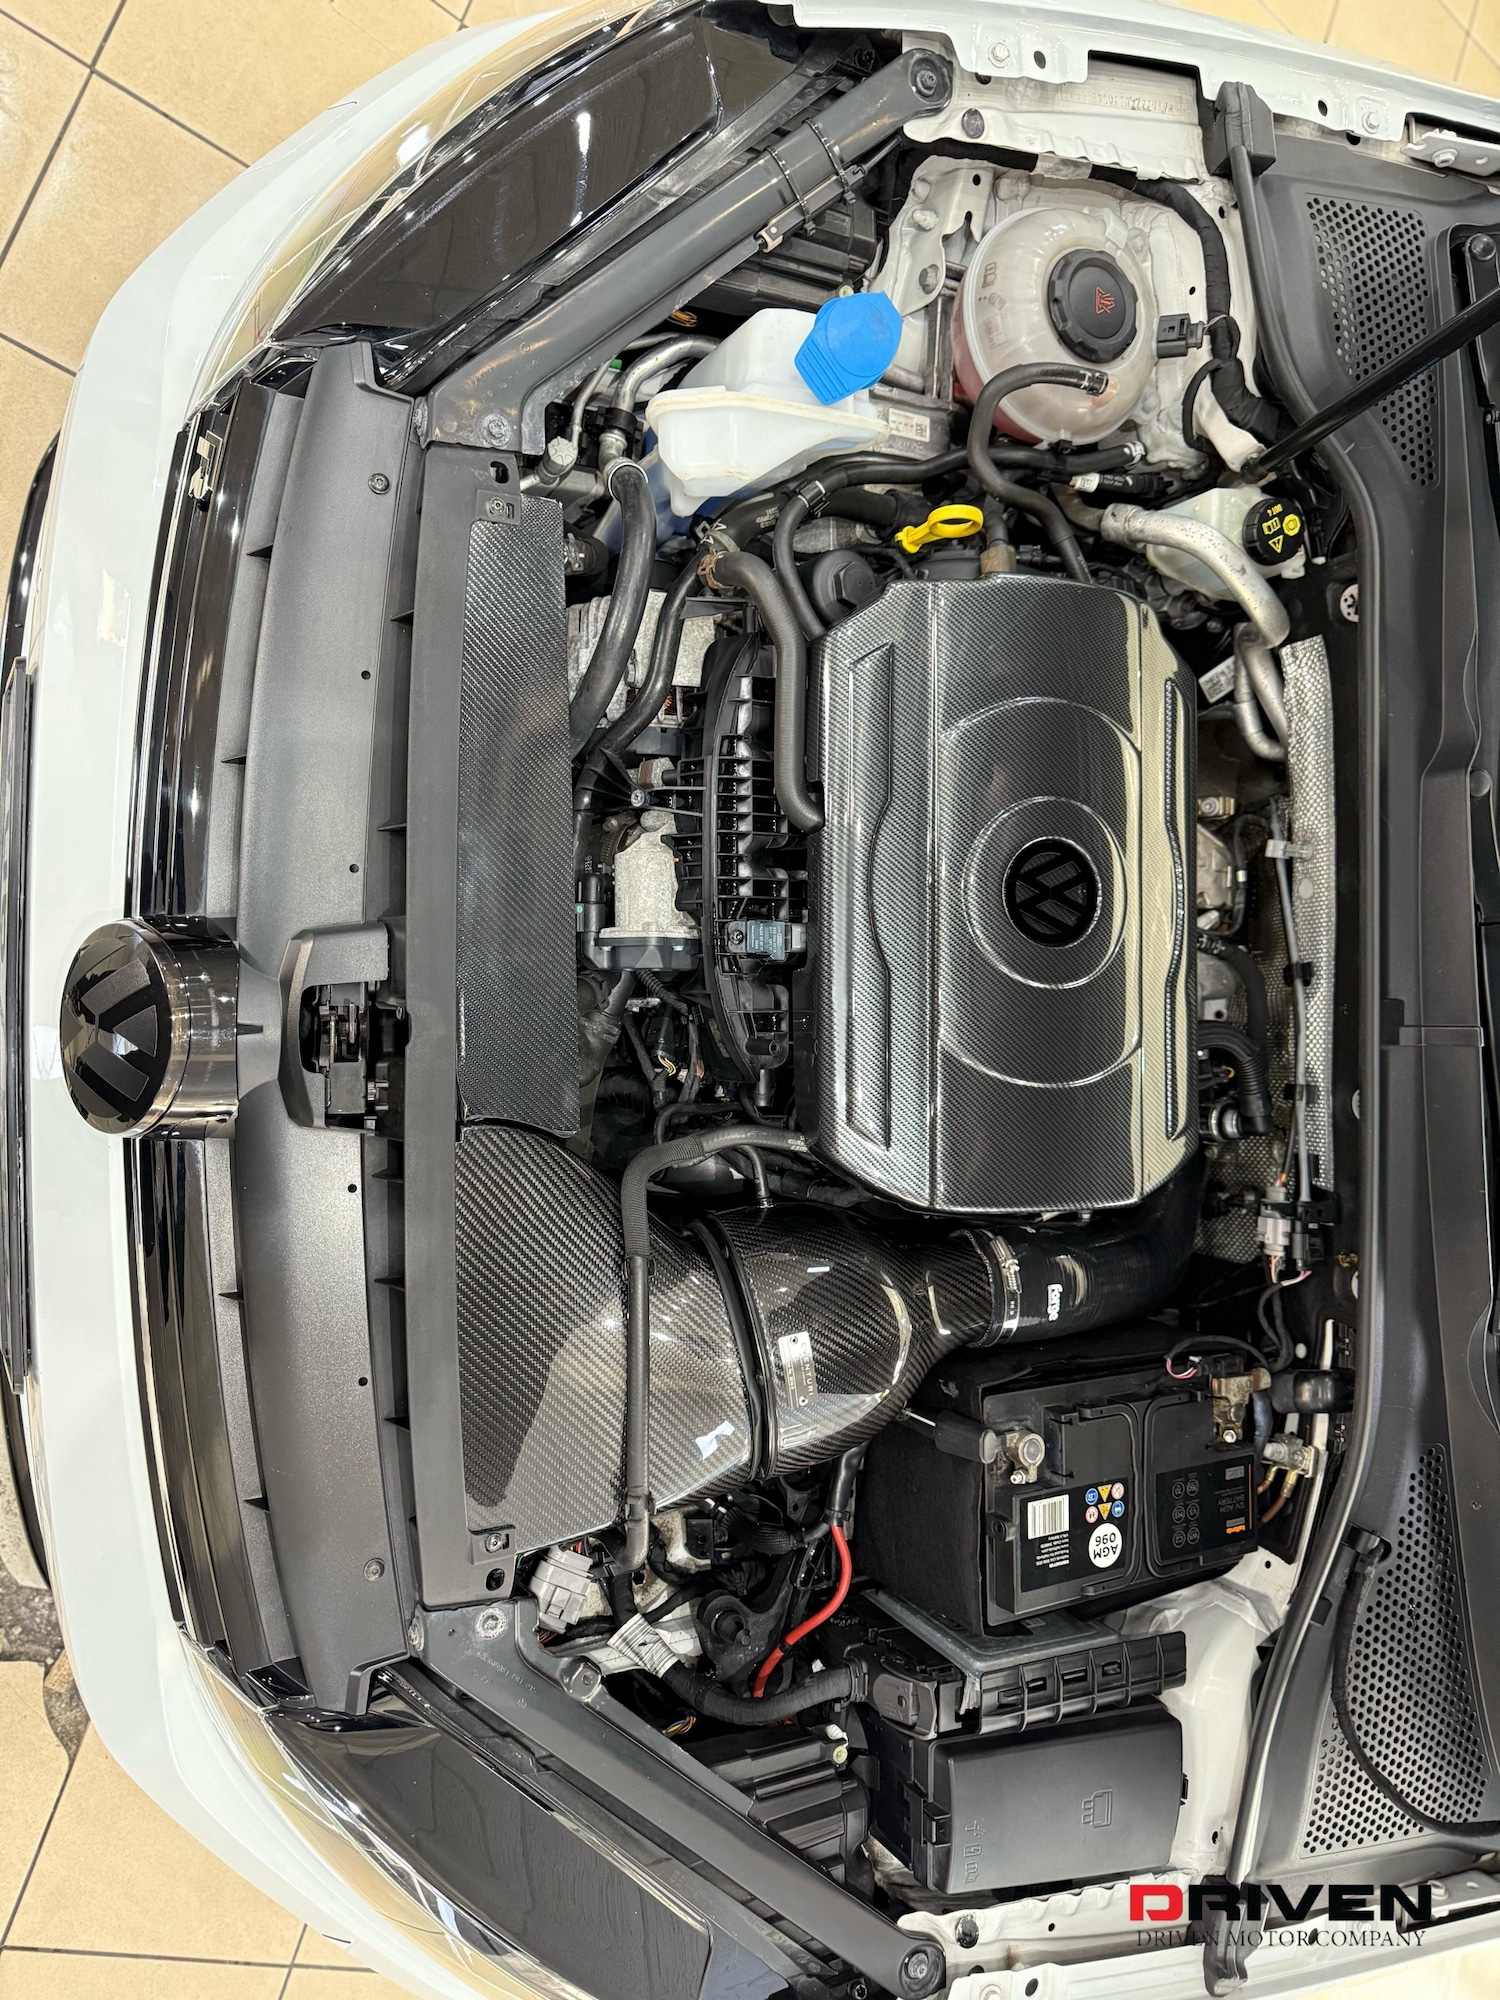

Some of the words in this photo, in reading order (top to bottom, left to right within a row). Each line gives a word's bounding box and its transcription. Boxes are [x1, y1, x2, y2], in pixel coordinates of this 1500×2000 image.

[1272, 504, 1283, 515] DOT
[1047, 1283, 1063, 1321] forge
[800, 1342, 814, 1397] EVENTURI
[1095, 1532, 1117, 1547] 096
[1093, 1543, 1119, 1560] AGM
